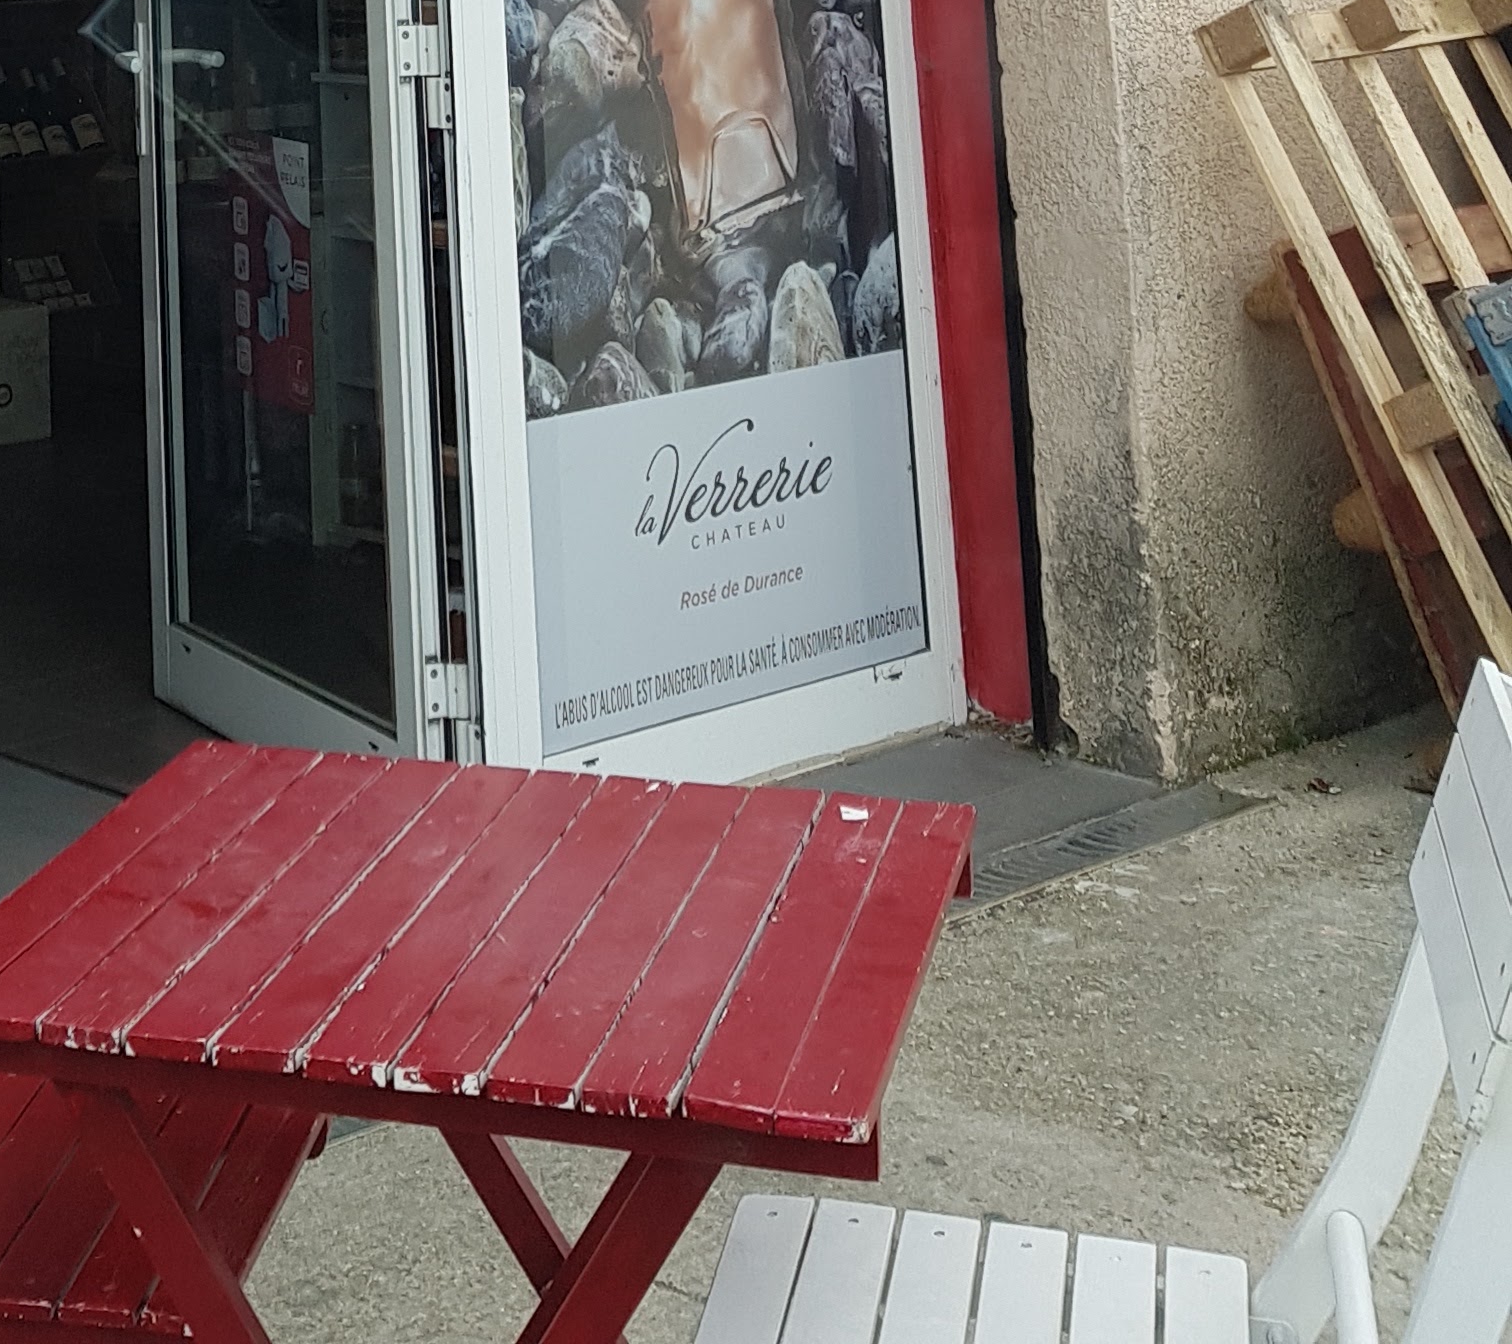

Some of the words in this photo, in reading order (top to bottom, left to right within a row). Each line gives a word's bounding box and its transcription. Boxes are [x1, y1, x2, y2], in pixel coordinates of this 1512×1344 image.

[646, 417, 834, 546] Verrerie
[691, 513, 787, 551] CHATEAU
[679, 582, 717, 612] Rosé
[721, 578, 740, 598] de
[744, 565, 804, 594] Durance
[554, 695, 589, 730] L'ABUS
[590, 685, 635, 718] D'ALCOOL
[635, 677, 653, 707] EST
[654, 664, 710, 701] DANGEREUX
[710, 655, 735, 683] POUR
[736, 652, 748, 676] LA
[788, 626, 845, 664] CONSOMMER
[845, 621, 867, 648] AVEC
